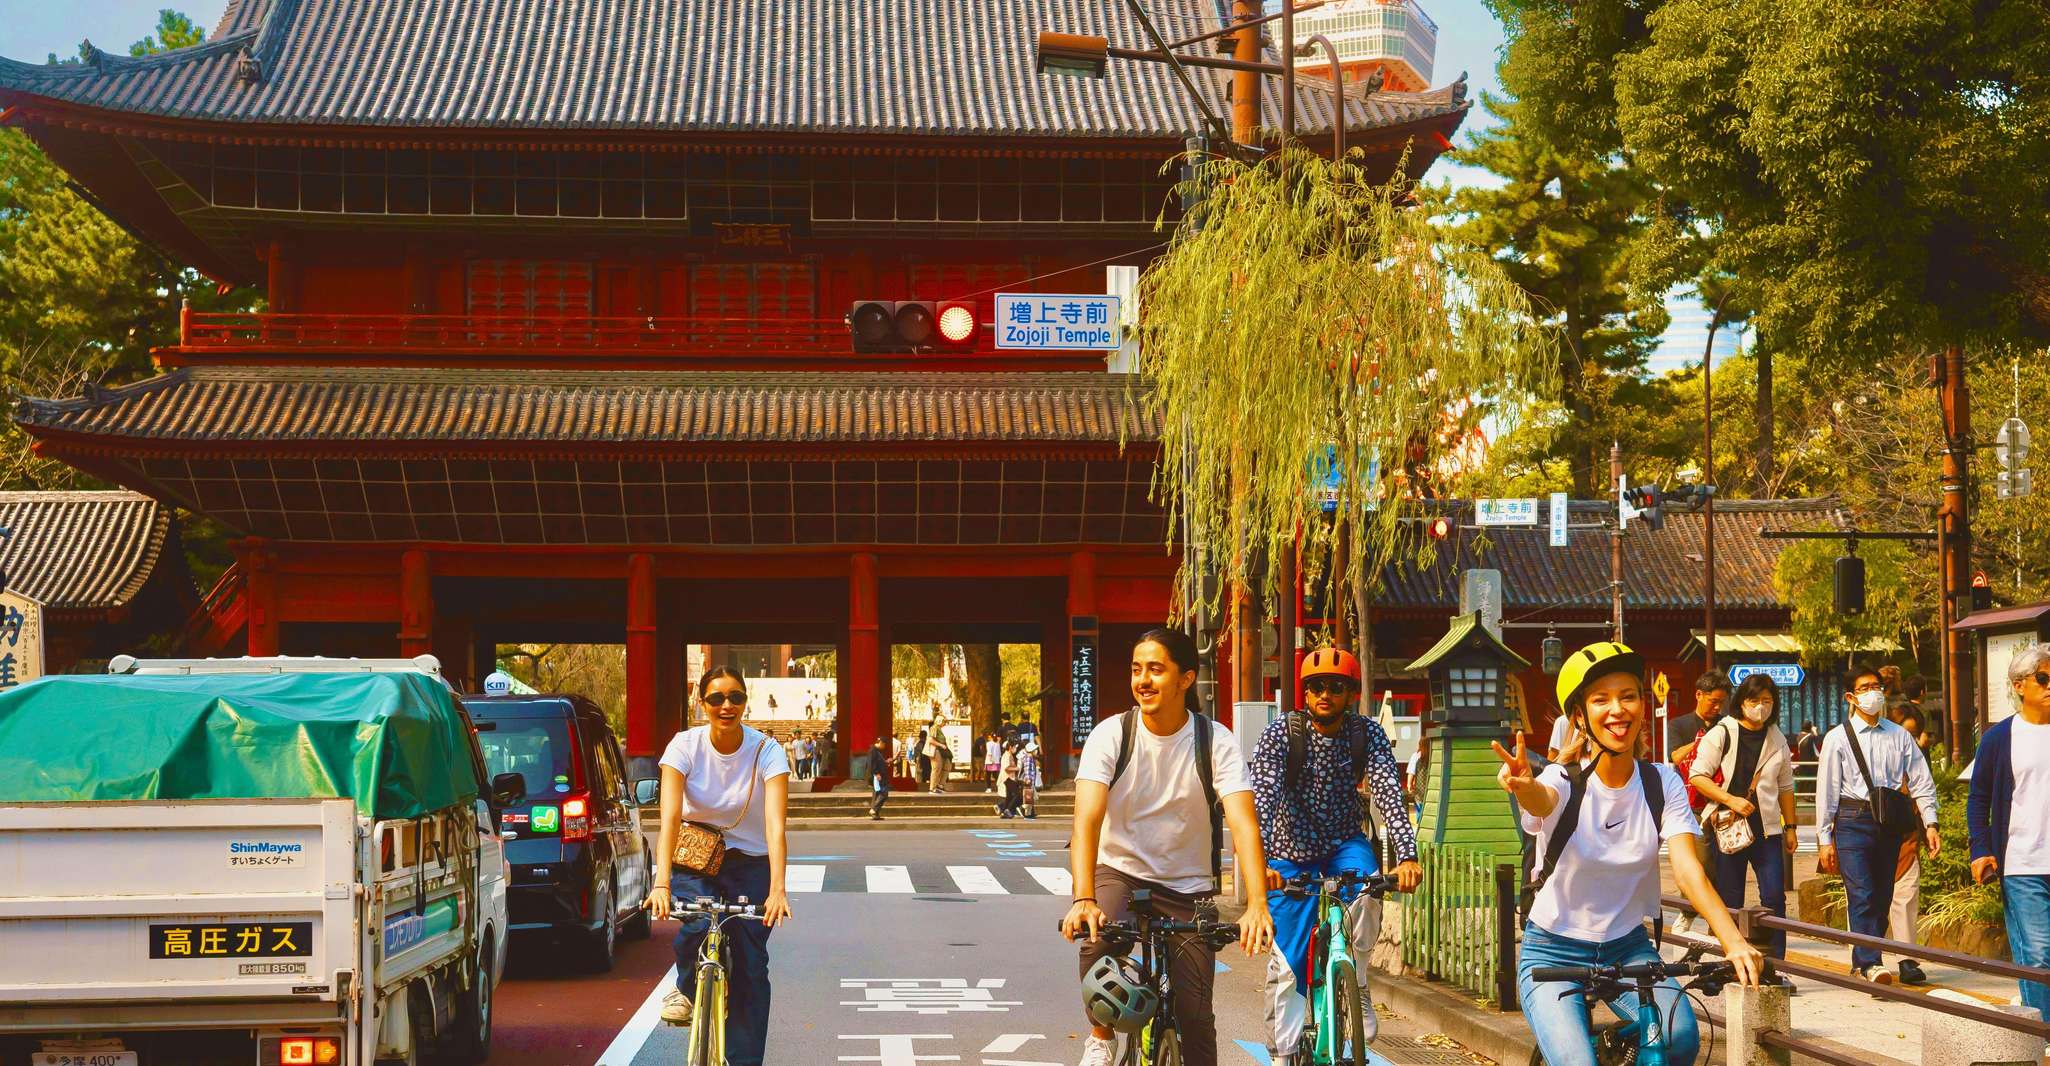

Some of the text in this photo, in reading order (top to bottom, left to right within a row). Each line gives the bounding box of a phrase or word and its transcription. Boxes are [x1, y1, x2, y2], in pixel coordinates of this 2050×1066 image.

[1009, 301, 1108, 324] 増上寺前
[1006, 326, 1111, 346] Zojoji Temple
[230, 842, 302, 854] ShinMaywa
[230, 855, 295, 866] すいちょくゲート
[163, 927, 297, 956] 高圧ガス
